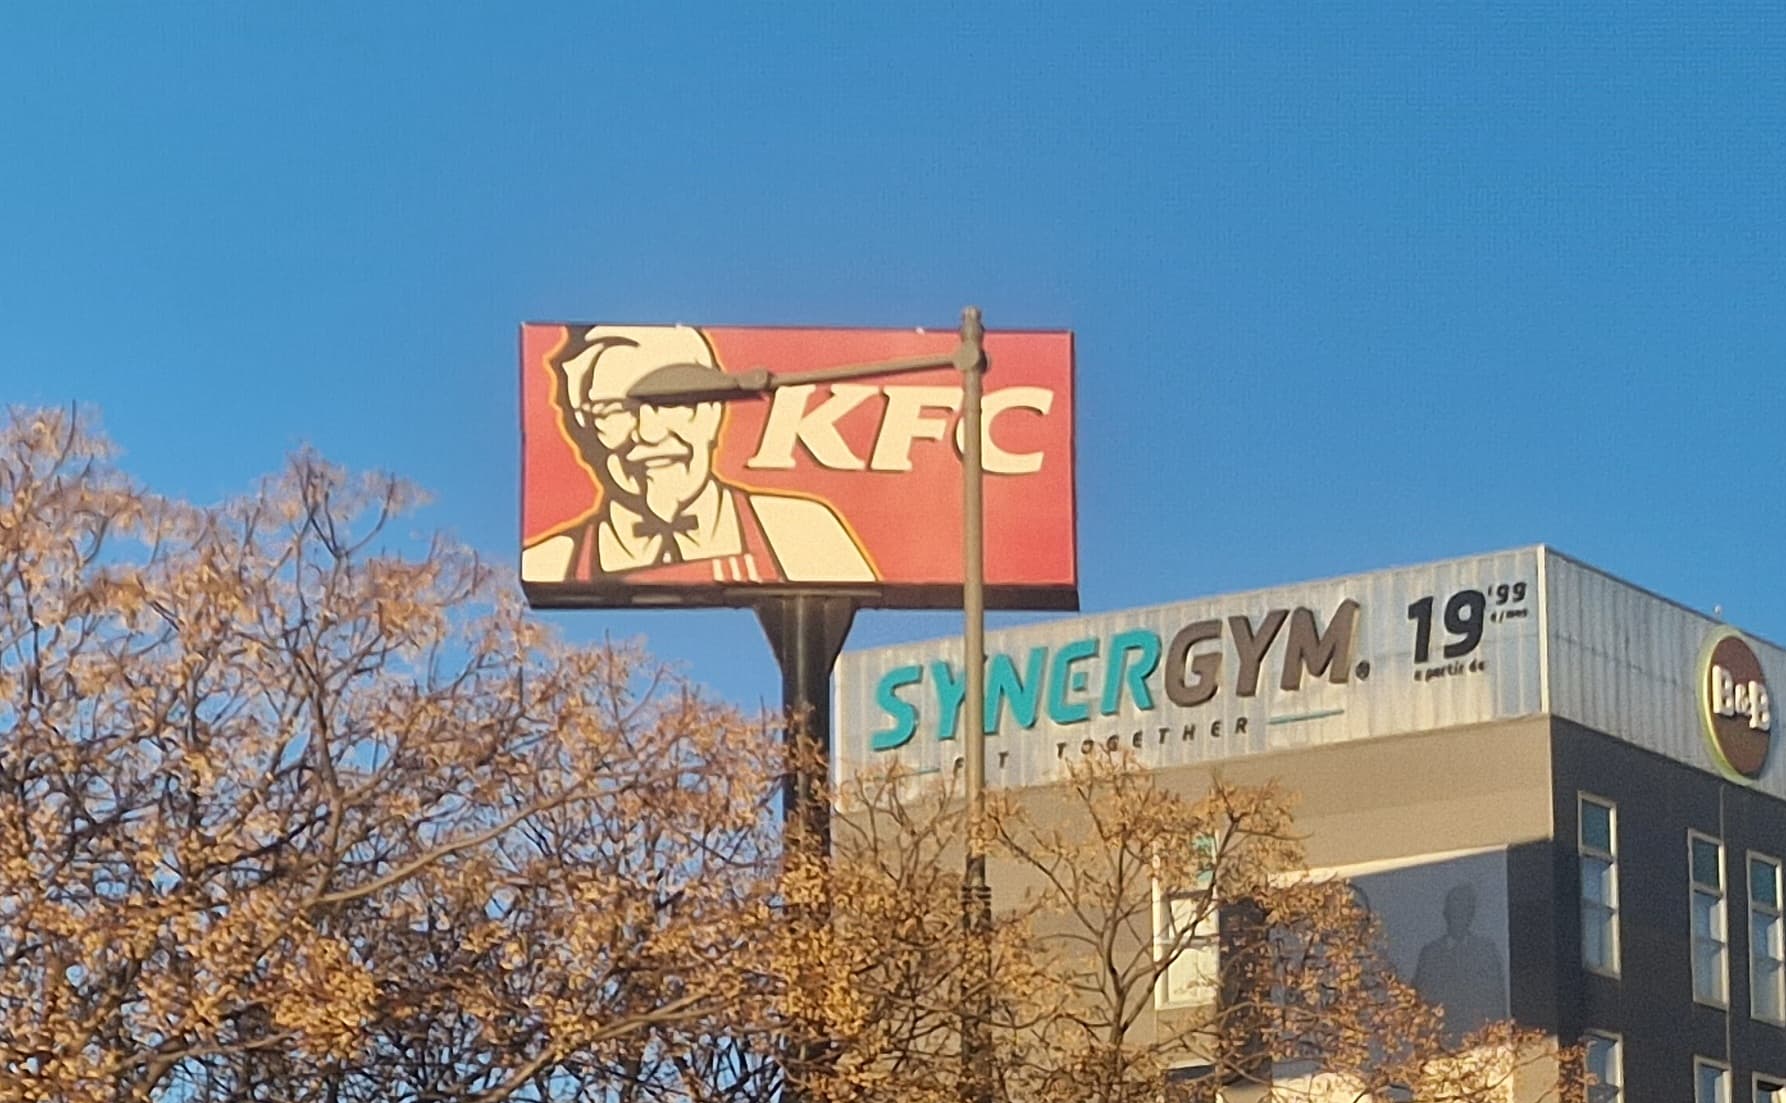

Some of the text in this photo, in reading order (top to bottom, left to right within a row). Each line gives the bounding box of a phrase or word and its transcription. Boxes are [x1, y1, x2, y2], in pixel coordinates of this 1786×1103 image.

[747, 384, 1054, 474] KFC
[1424, 661, 1466, 683] partir
[1711, 663, 1771, 732] B&B
[953, 716, 1250, 773] FT TOGETHER
